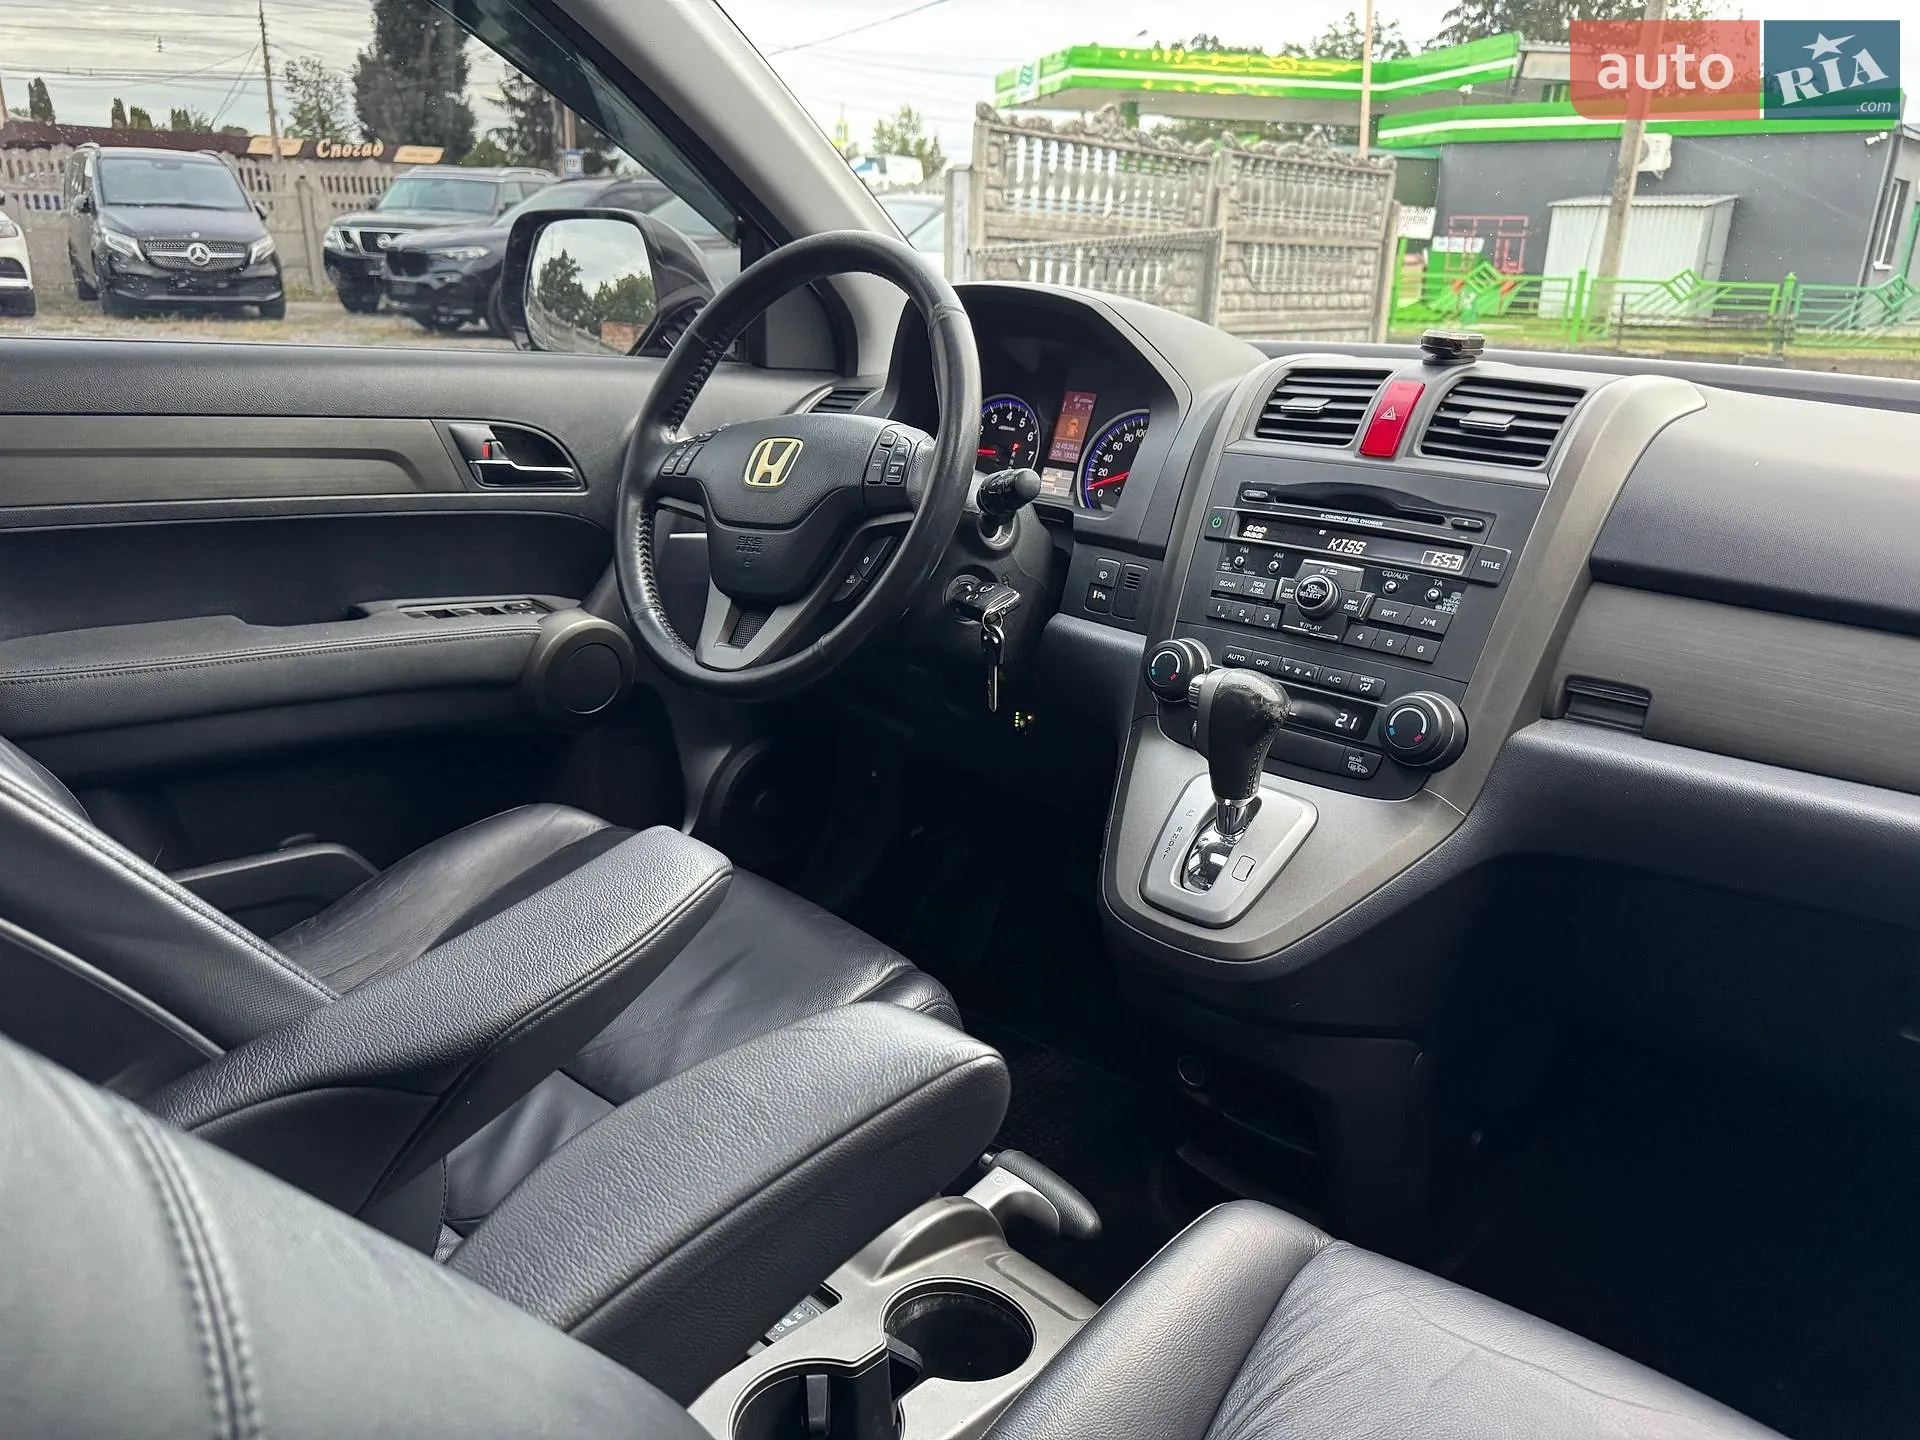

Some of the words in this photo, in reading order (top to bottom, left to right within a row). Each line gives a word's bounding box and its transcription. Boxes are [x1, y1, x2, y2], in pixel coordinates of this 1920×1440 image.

[991, 414, 998, 424] 3
[1006, 411, 1013, 422] 4
[1019, 417, 1026, 428] 5
[1027, 431, 1034, 442] 6
[1124, 433, 1134, 442] 80
[1112, 442, 1123, 451] 60
[1028, 450, 1035, 461] 7
[1102, 454, 1113, 463] 40
[1097, 467, 1108, 477] 20
[1097, 488, 1104, 498] 0
[1327, 538, 1367, 554] KISS
[1480, 559, 1501, 570] TITLE
[1382, 570, 1409, 581] CD/AUX
[1219, 580, 1237, 588] SCAN
[1433, 579, 1443, 587] TA
[1300, 591, 1321, 599] SELECT
[1343, 603, 1359, 611] SEEK
[1238, 609, 1245, 617] 2
[1263, 613, 1270, 621] 3
[1380, 608, 1398, 618] RPT
[1356, 632, 1364, 641] 4
[1386, 639, 1393, 647] 5
[1417, 645, 1424, 653] 6
[1227, 653, 1246, 662] AUTO
[1255, 658, 1270, 667] OFF
[1327, 675, 1342, 684] A/C
[1334, 713, 1358, 730] 21
